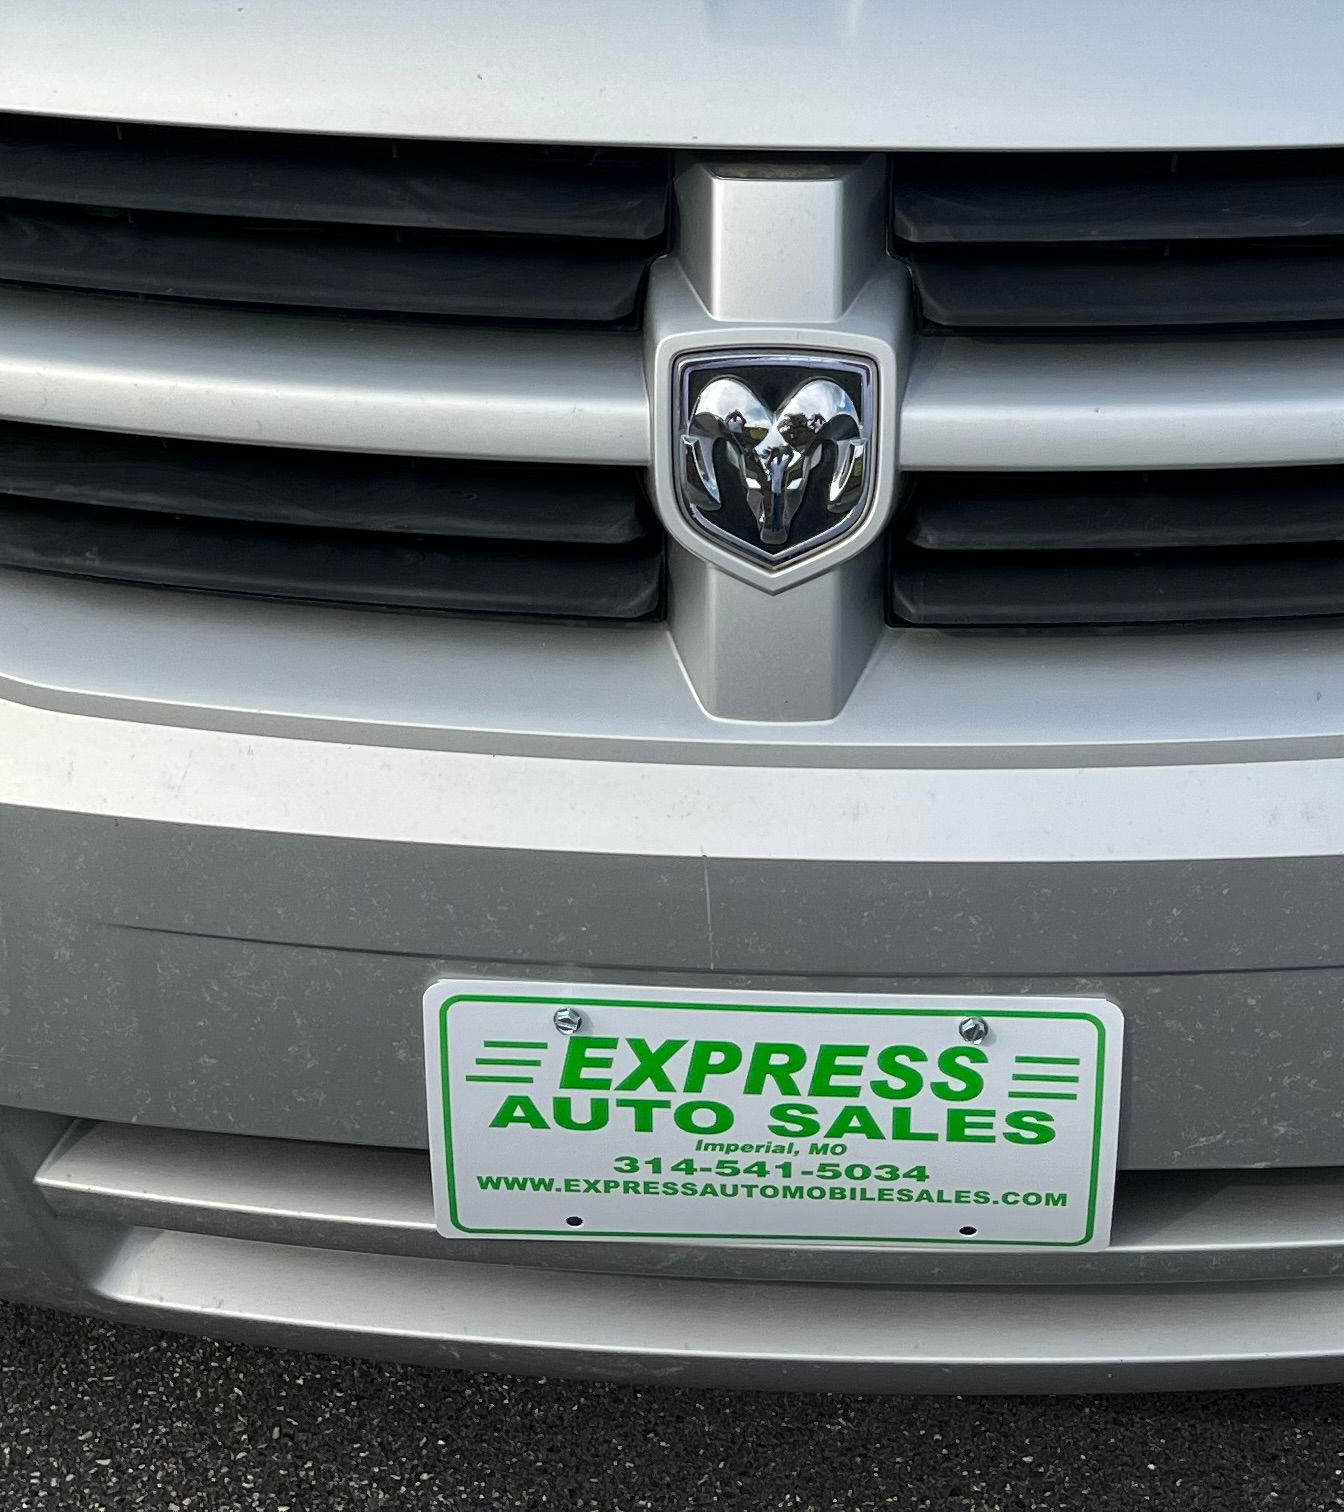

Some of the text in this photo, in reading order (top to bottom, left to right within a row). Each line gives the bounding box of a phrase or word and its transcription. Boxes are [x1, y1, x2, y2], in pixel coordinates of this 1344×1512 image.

[558, 1034, 990, 1102] EXPRESS
[487, 1094, 1058, 1146] AUTO SALES
[694, 1138, 849, 1158] Imperial, MO
[612, 1155, 931, 1183] 314-541-5034
[475, 1175, 1069, 1207] WWW.EXPRESSAUTOMOBILESALES.COM
